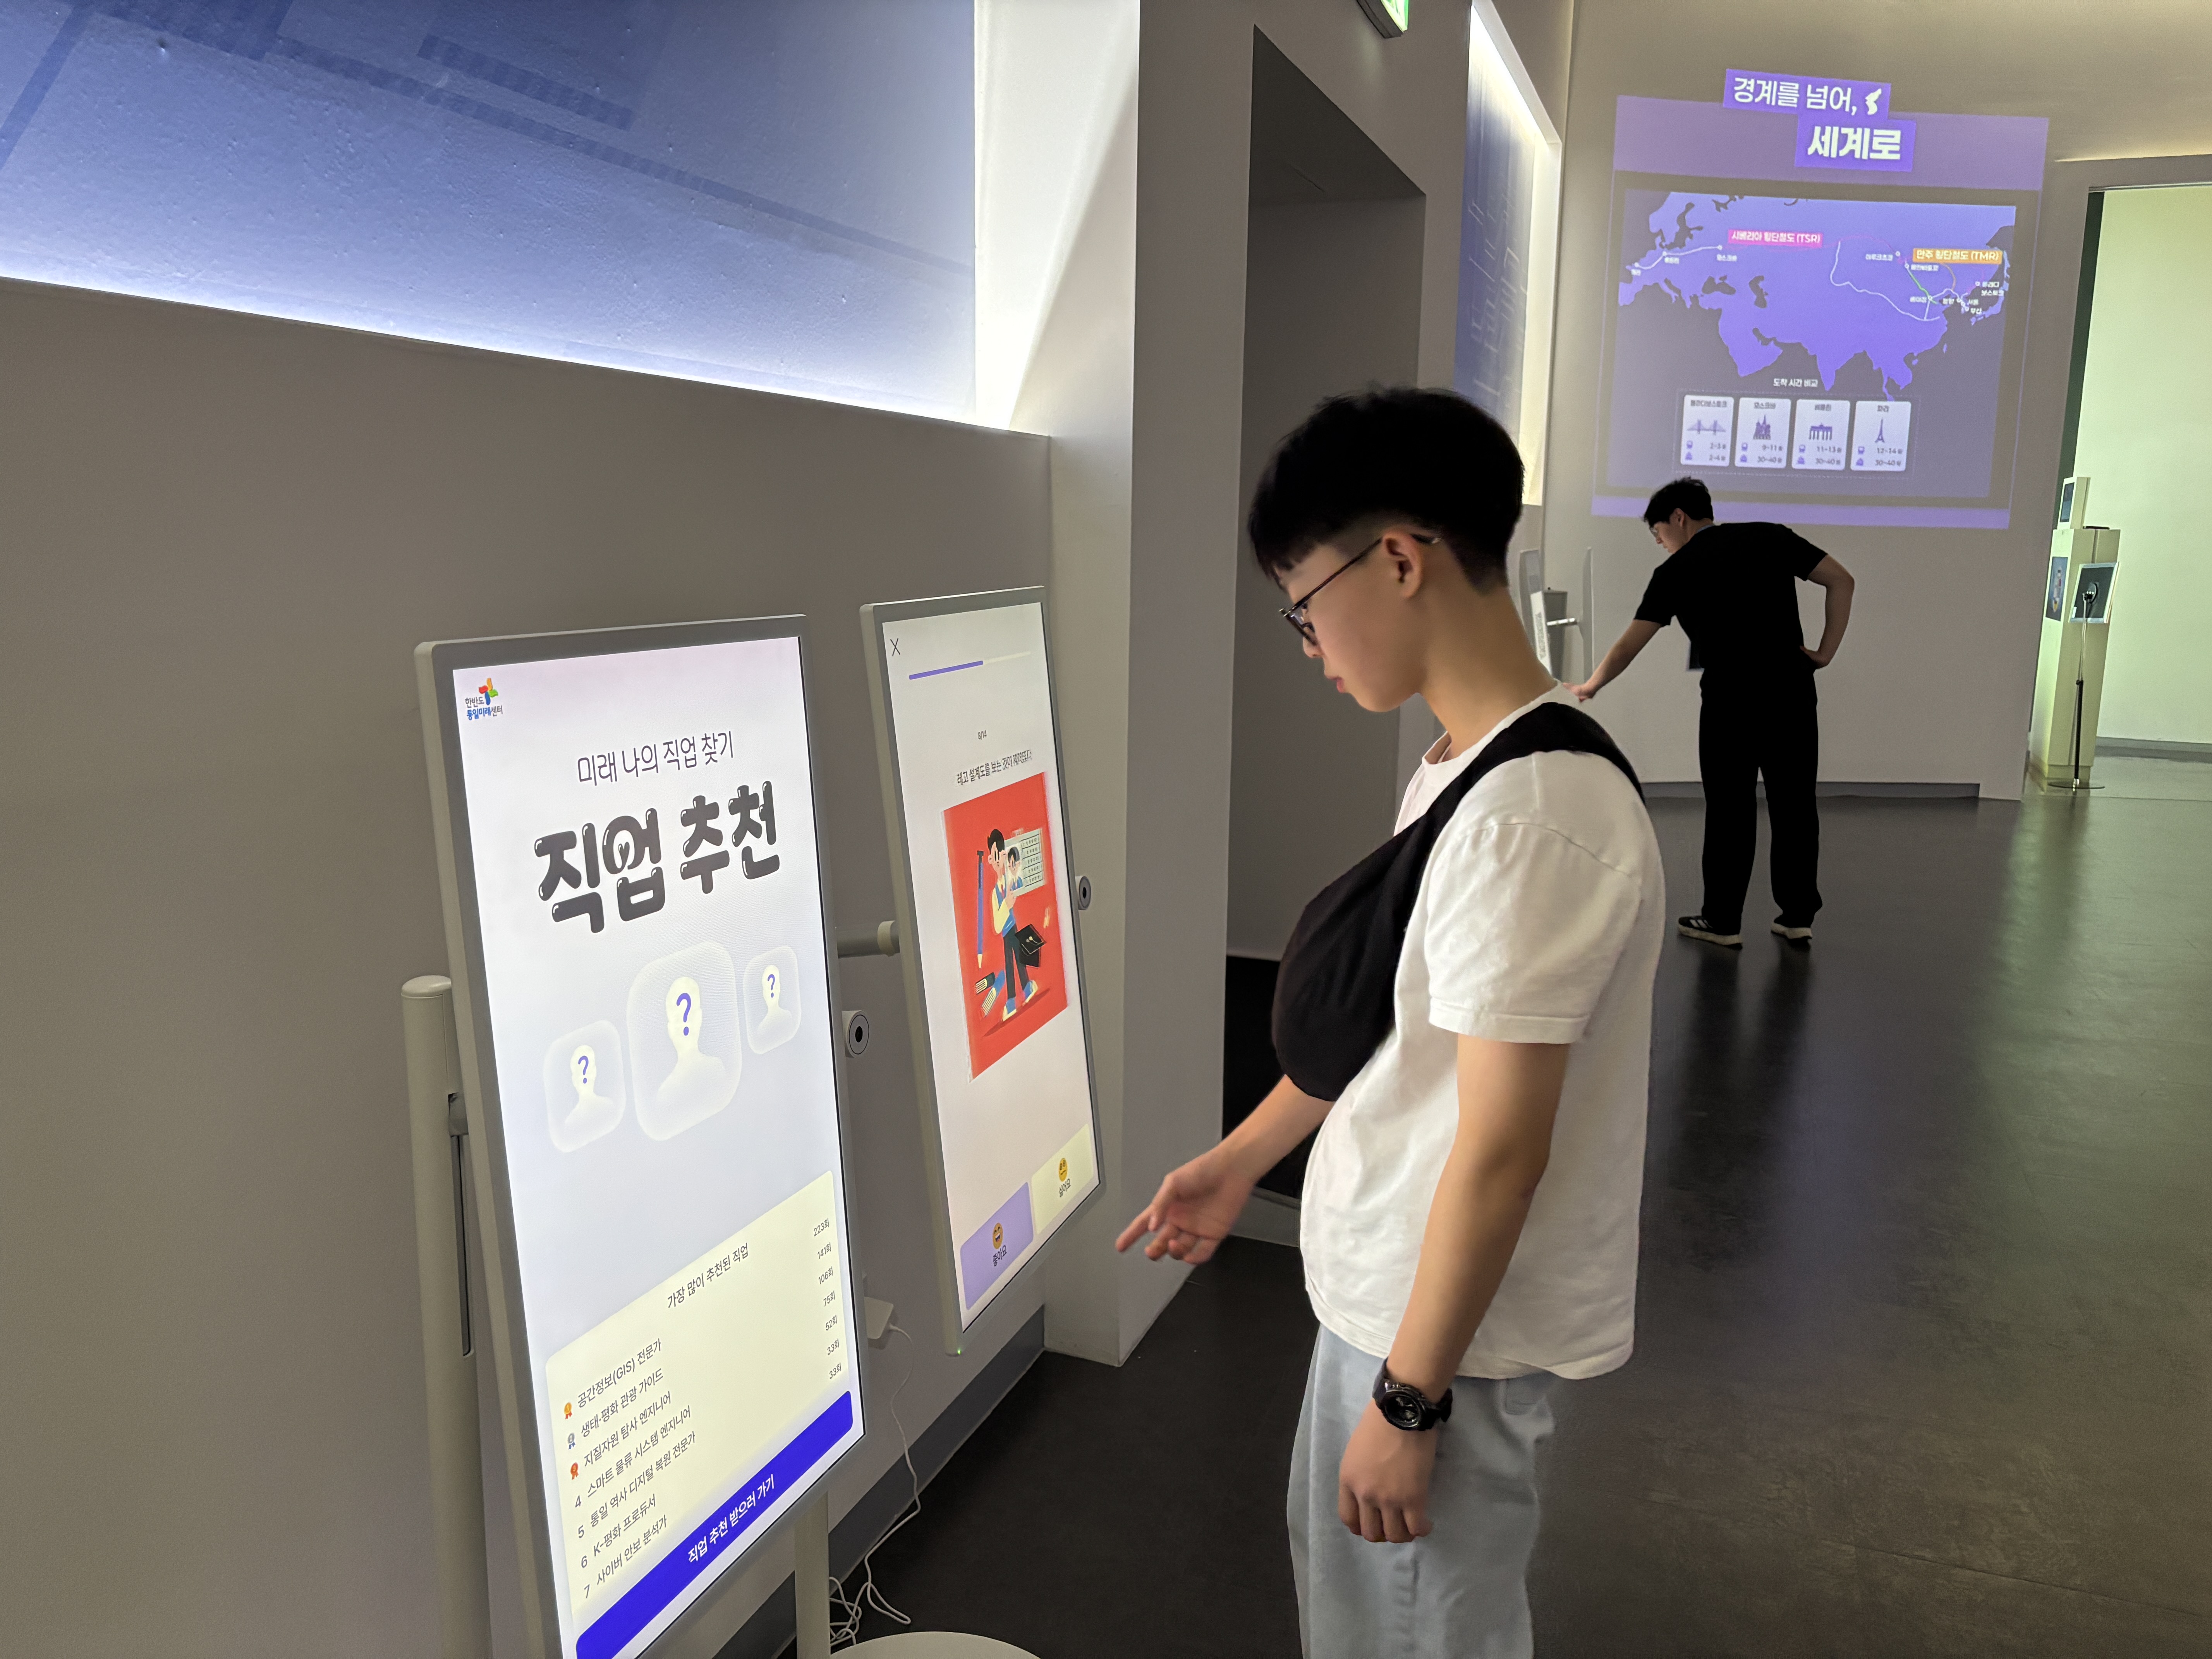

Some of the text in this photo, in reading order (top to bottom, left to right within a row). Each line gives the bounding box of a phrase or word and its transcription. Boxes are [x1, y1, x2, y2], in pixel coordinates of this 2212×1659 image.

[1734, 77, 1857, 115] 경계를 넘어,
[1807, 126, 1901, 160] 세계로
[1731, 231, 1762, 241] 시베리아
[1796, 233, 1820, 244] (TSR)
[1916, 249, 1934, 259] 만주
[1970, 251, 1999, 261] (TMR)
[1773, 378, 1818, 387] 도착 시간 비교
[465, 697, 484, 708] 한반도
[467, 705, 503, 720] 통일미래센터
[977, 730, 987, 740] 8/14
[577, 730, 733, 786] 미래 나의 직업 찾기
[534, 780, 780, 934] 직업 추천
[767, 974, 776, 998] ?
[676, 992, 692, 1036] ?
[578, 1055, 589, 1084] ?
[813, 1218, 829, 1237] 223회
[817, 1242, 831, 1259] 141회
[993, 1245, 1007, 1267] 좋아요
[667, 1242, 748, 1308] 가장 많이 추천된 직업
[818, 1266, 833, 1285] 106회
[823, 1290, 835, 1307] 75회
[825, 1314, 837, 1331] 52회
[827, 1338, 840, 1355] 33회
[577, 1338, 662, 1408] 공간정보(GIS) 전문가
[829, 1362, 842, 1379] 33회
[581, 1368, 663, 1437] 생태·평화 관광 가이드
[584, 1391, 672, 1467] 지질자원 탐사 엔지니어
[575, 1405, 691, 1508] 4 스마트 물류 시스템 엔지니어
[578, 1431, 696, 1539] 5 통일 역사 디지털 복원 전문가
[581, 1493, 656, 1568] 6 K-평화 프로듀서
[688, 1474, 774, 1563] 직업 추천 받으러 가기
[584, 1514, 667, 1599] 7 사이버 안보 분석가
